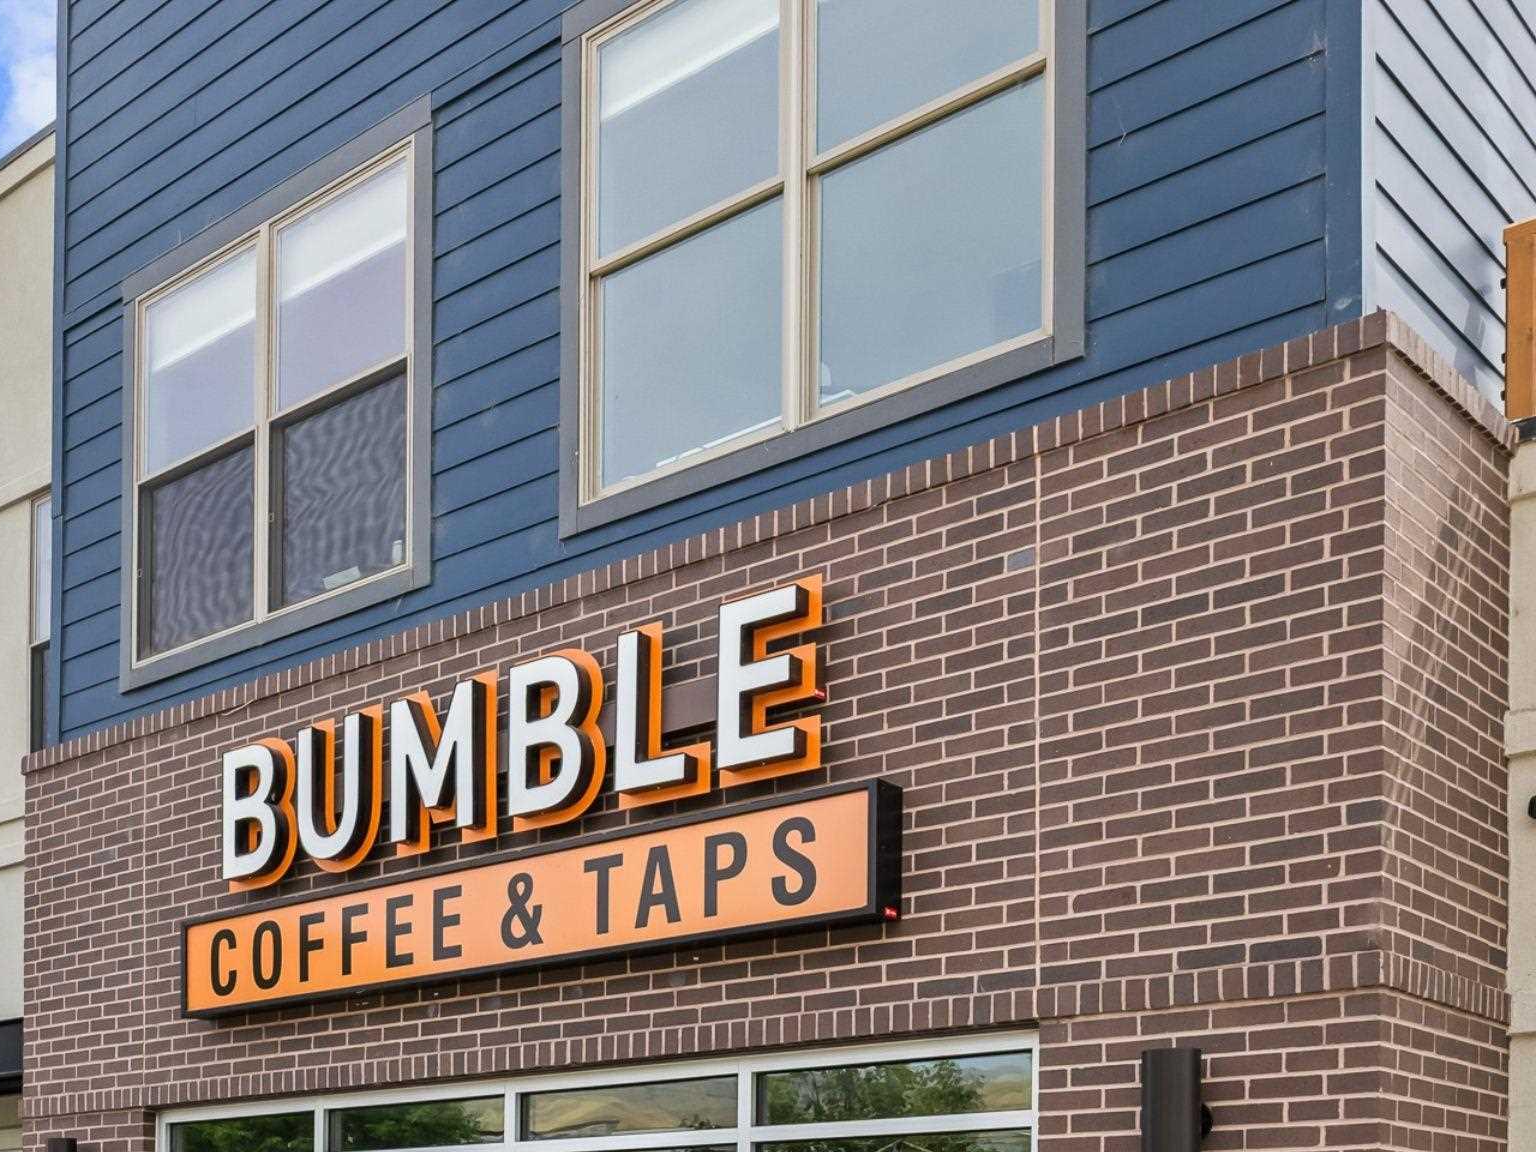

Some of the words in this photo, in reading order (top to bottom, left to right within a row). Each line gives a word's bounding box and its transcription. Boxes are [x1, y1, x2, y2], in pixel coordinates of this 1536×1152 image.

[222, 577, 823, 892] BUMBLE
[210, 884, 463, 997] COFFEE
[501, 872, 544, 949] &
[583, 816, 817, 935] TAPS
